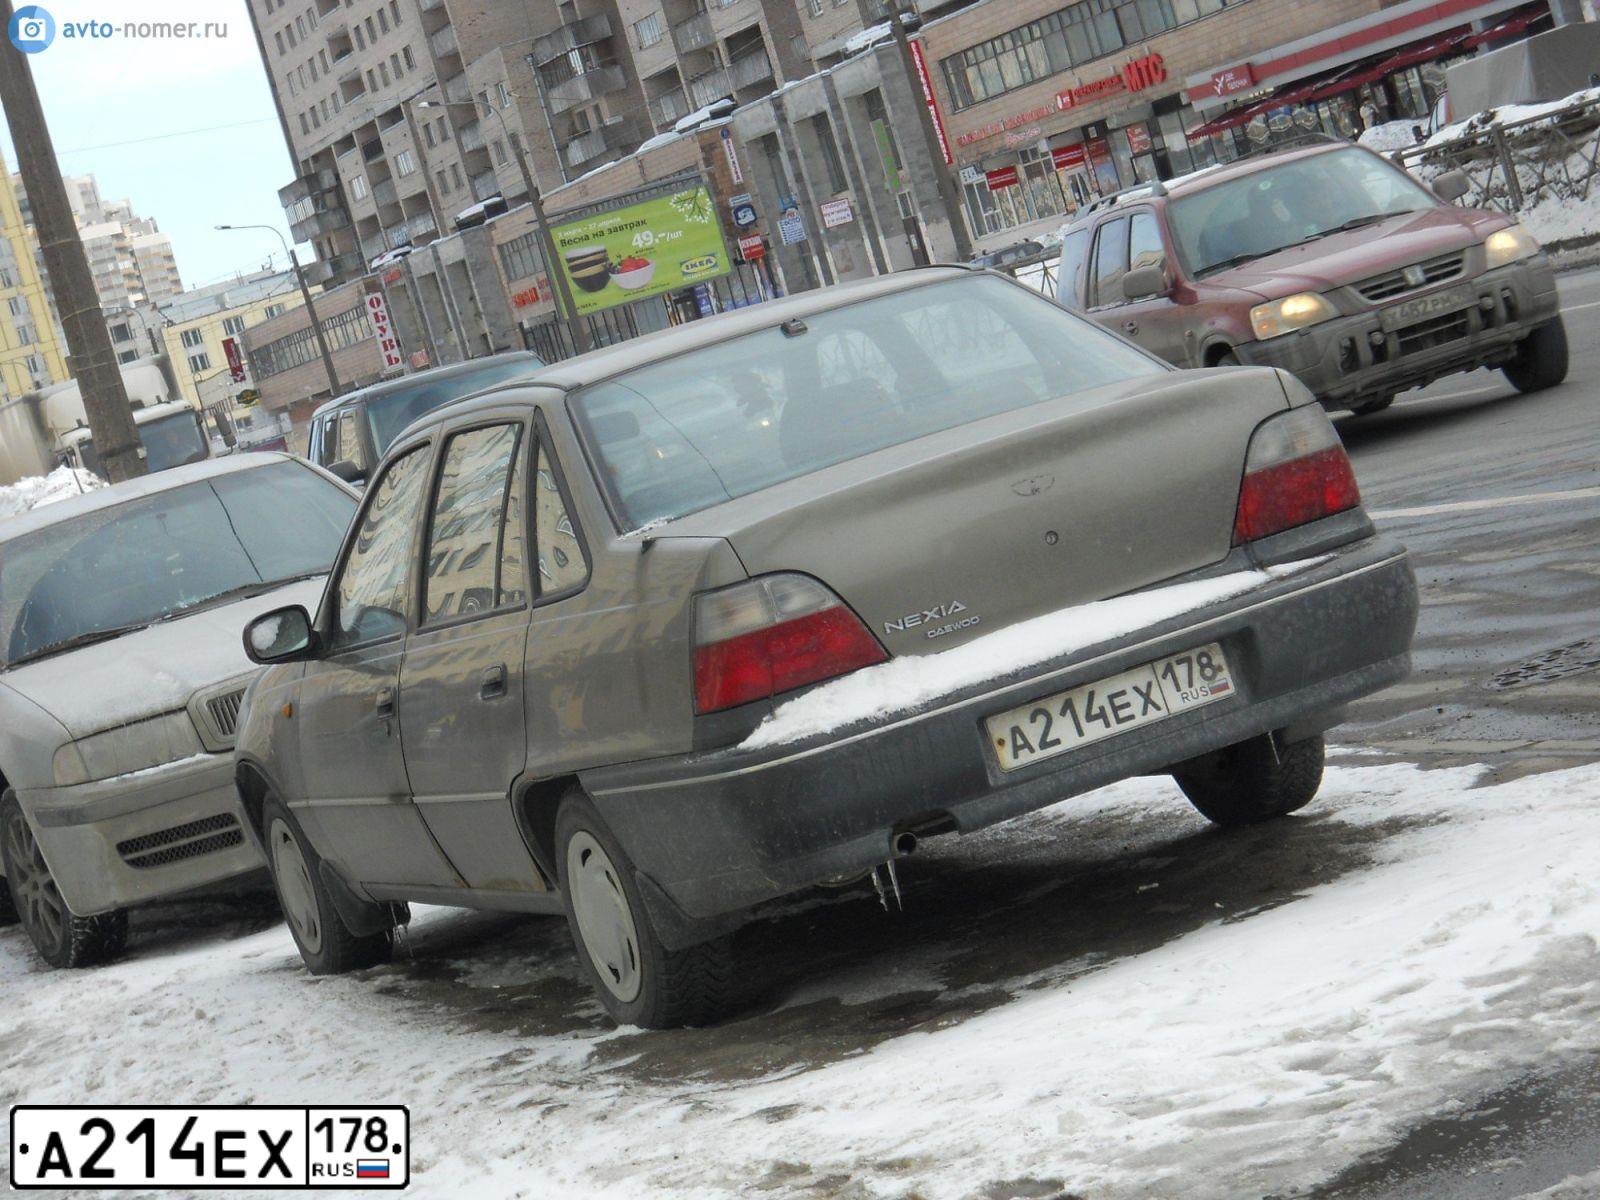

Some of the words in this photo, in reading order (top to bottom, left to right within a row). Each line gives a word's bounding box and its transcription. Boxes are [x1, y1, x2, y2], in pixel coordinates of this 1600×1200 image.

[1123, 53, 1167, 93] МТС
[560, 234, 590, 248] Весна
[592, 230, 605, 240] на
[607, 219, 648, 235] завтрак
[686, 258, 713, 271] IKEA
[369, 296, 400, 367] ОБУВЬ
[884, 600, 967, 634] NEXIA
[926, 615, 981, 638] DAEWOO
[1161, 650, 1219, 693] 178
[1181, 686, 1209, 703] RUS
